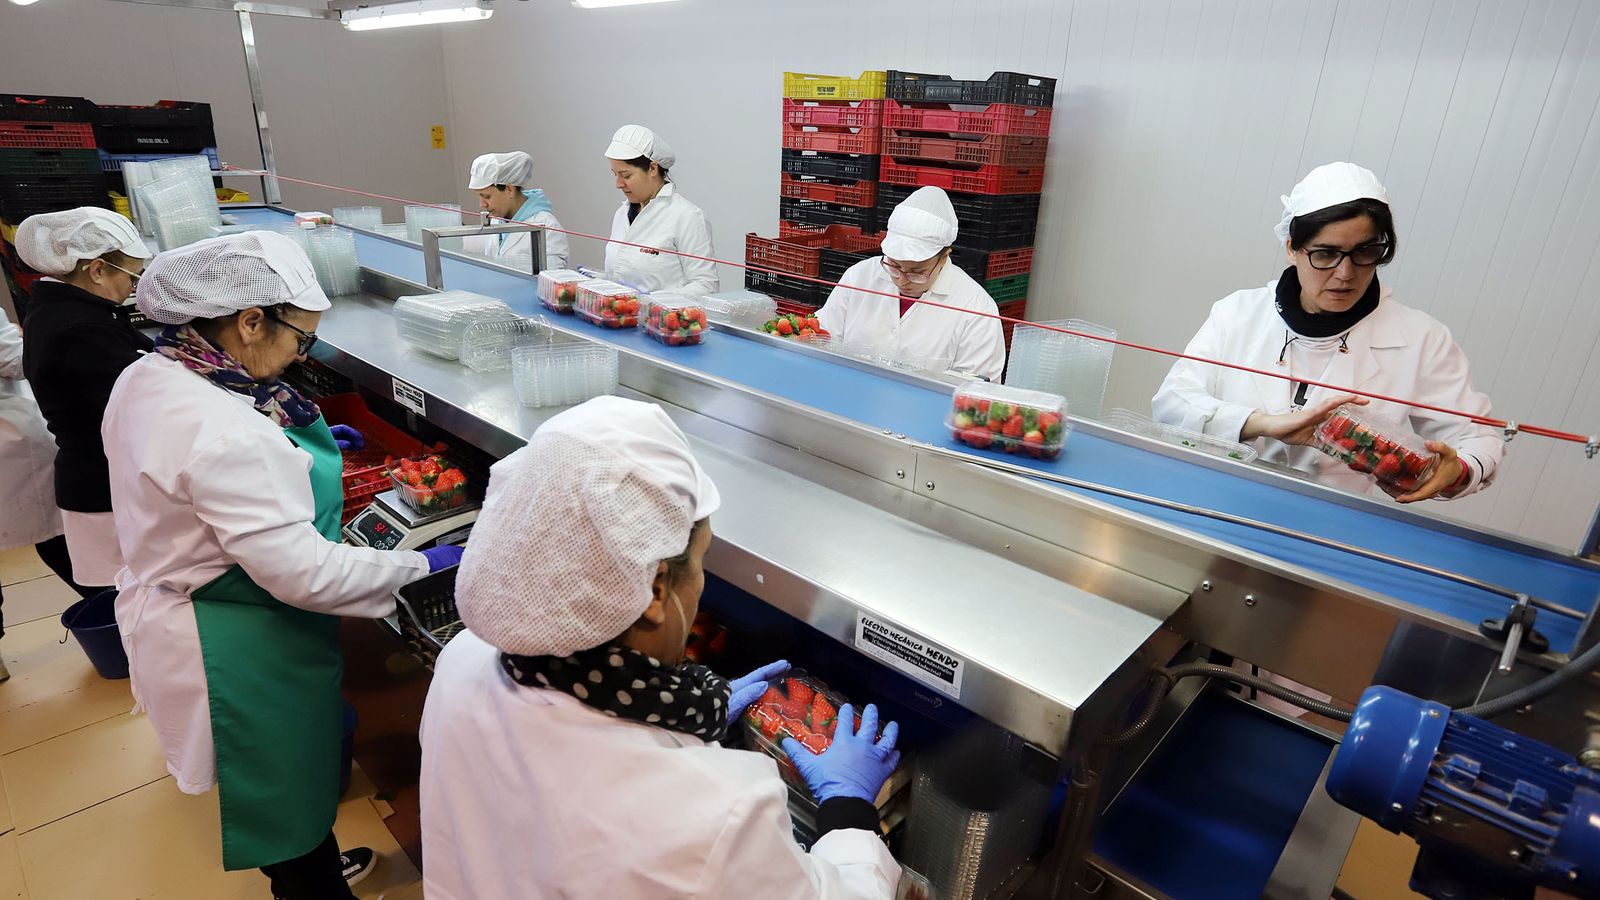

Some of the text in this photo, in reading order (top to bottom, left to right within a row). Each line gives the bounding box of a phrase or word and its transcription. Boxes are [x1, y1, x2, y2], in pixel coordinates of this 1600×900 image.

[861, 617, 889, 635] ELECTRO
[889, 631, 923, 651] MECÁNICA
[925, 647, 959, 668] MENDO
[865, 628, 897, 648] Construcciones
[924, 658, 952, 676] Industriales
[918, 661, 941, 677] Industrial
